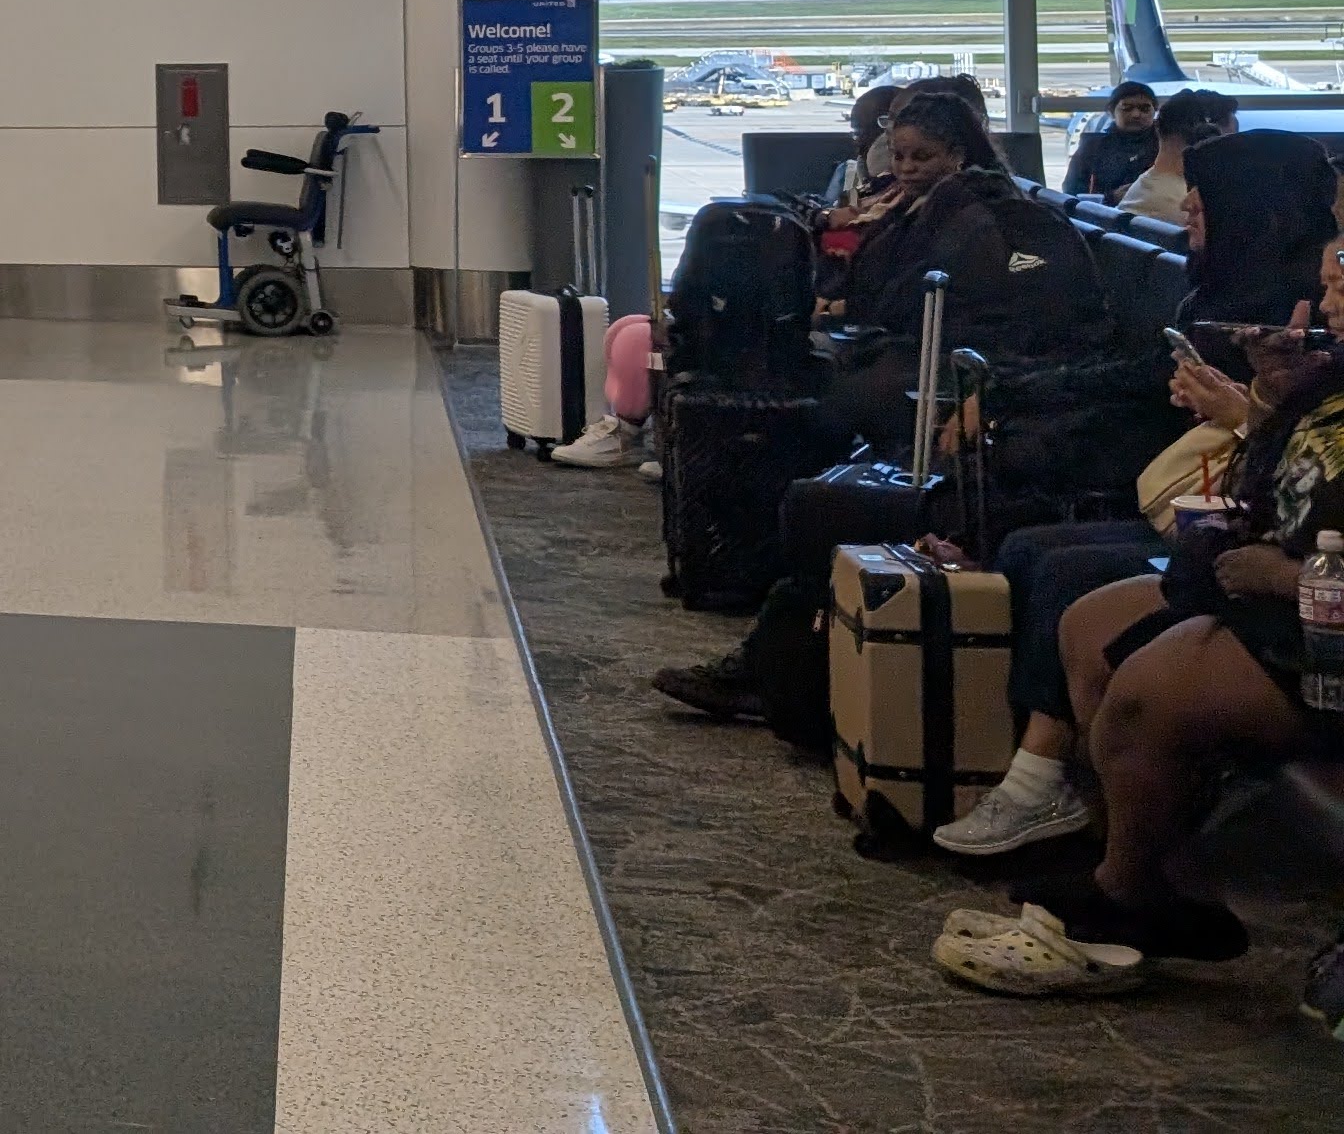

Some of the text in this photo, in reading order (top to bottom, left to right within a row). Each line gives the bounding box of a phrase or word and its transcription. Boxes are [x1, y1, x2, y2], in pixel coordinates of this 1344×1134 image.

[468, 22, 551, 39] Welcome!
[468, 43, 588, 54] Groups 3-5 please have
[468, 54, 583, 65] a seat until your group
[468, 65, 510, 74] is called.
[486, 92, 507, 124] 1
[551, 92, 574, 123] 2
